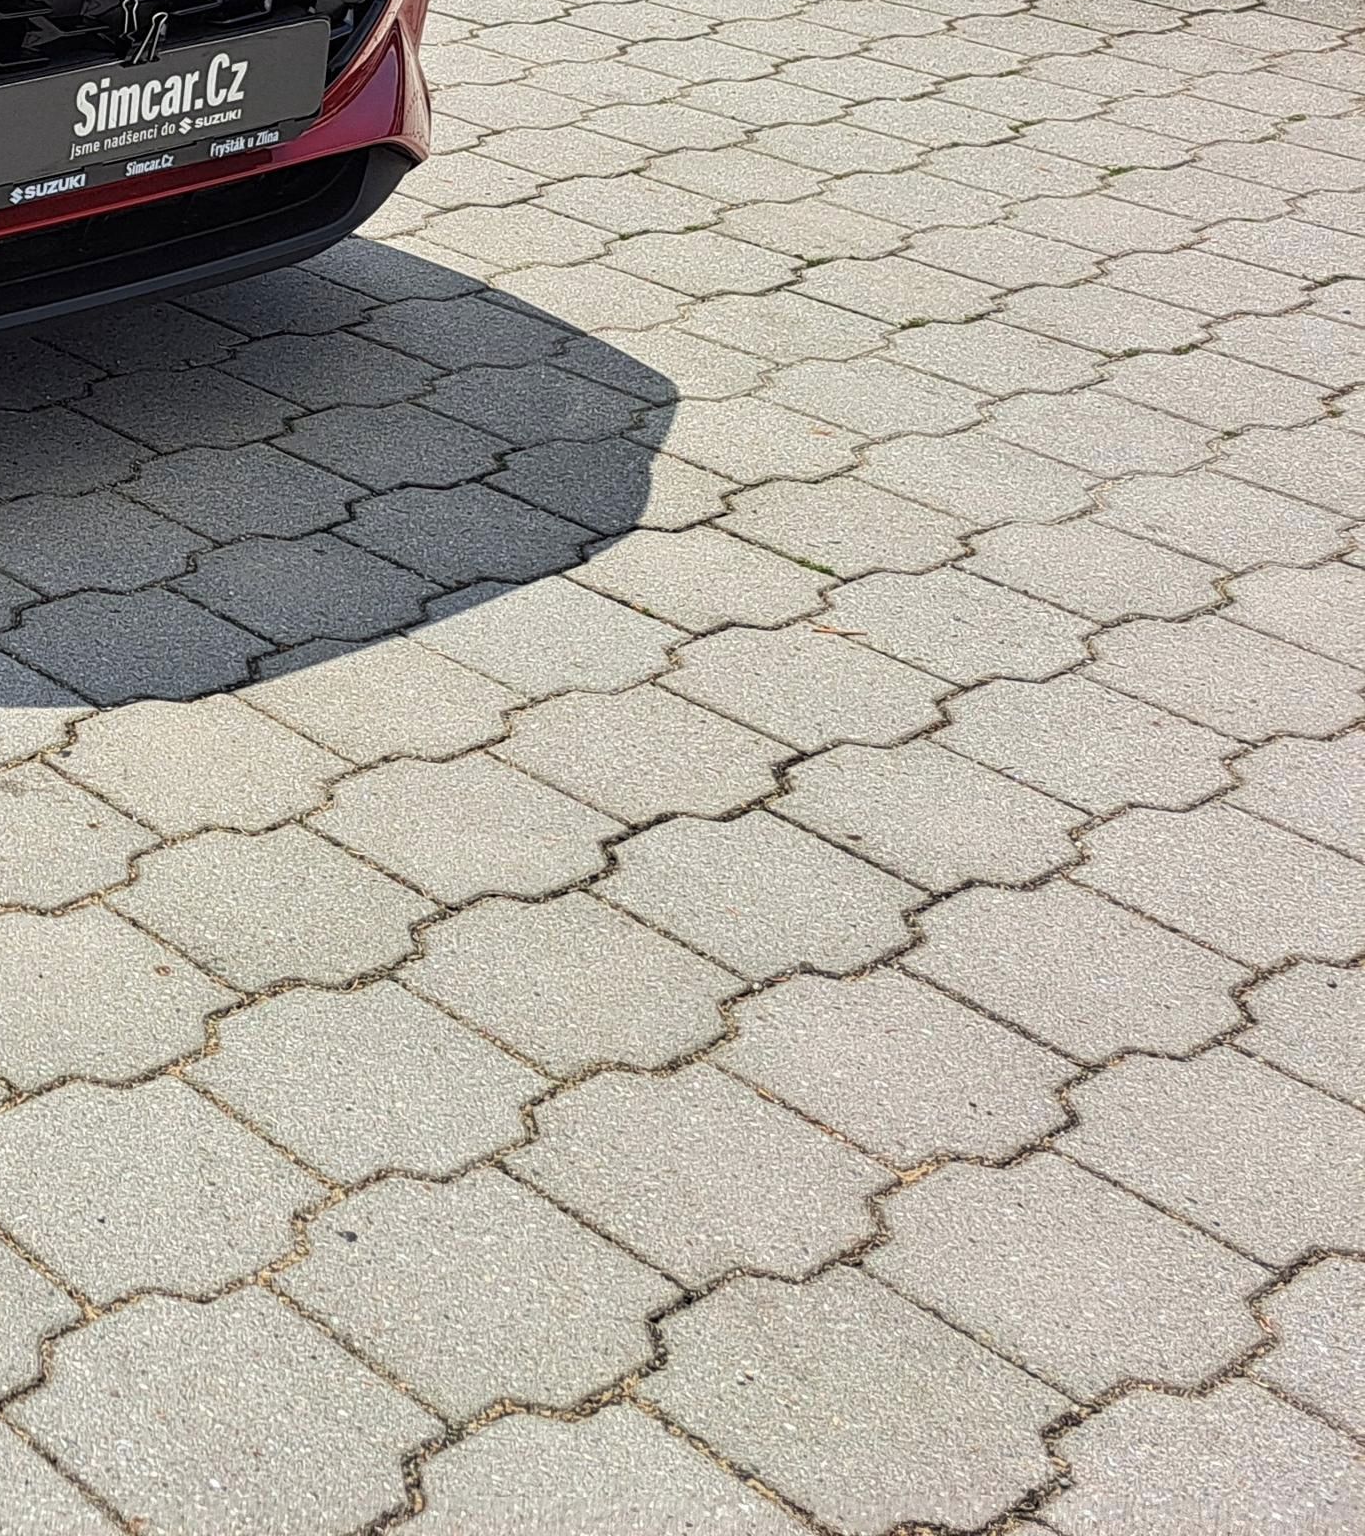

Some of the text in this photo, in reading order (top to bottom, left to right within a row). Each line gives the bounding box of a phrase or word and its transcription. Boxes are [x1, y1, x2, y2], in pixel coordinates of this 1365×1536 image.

[73, 52, 248, 137] Simcar.Cz
[70, 109, 242, 160] jsme nadšenci do SUZUKI
[210, 129, 279, 157] Fryšták u Zlína
[125, 153, 174, 177] Simcar.Cz
[21, 173, 86, 197] SUZUKI
